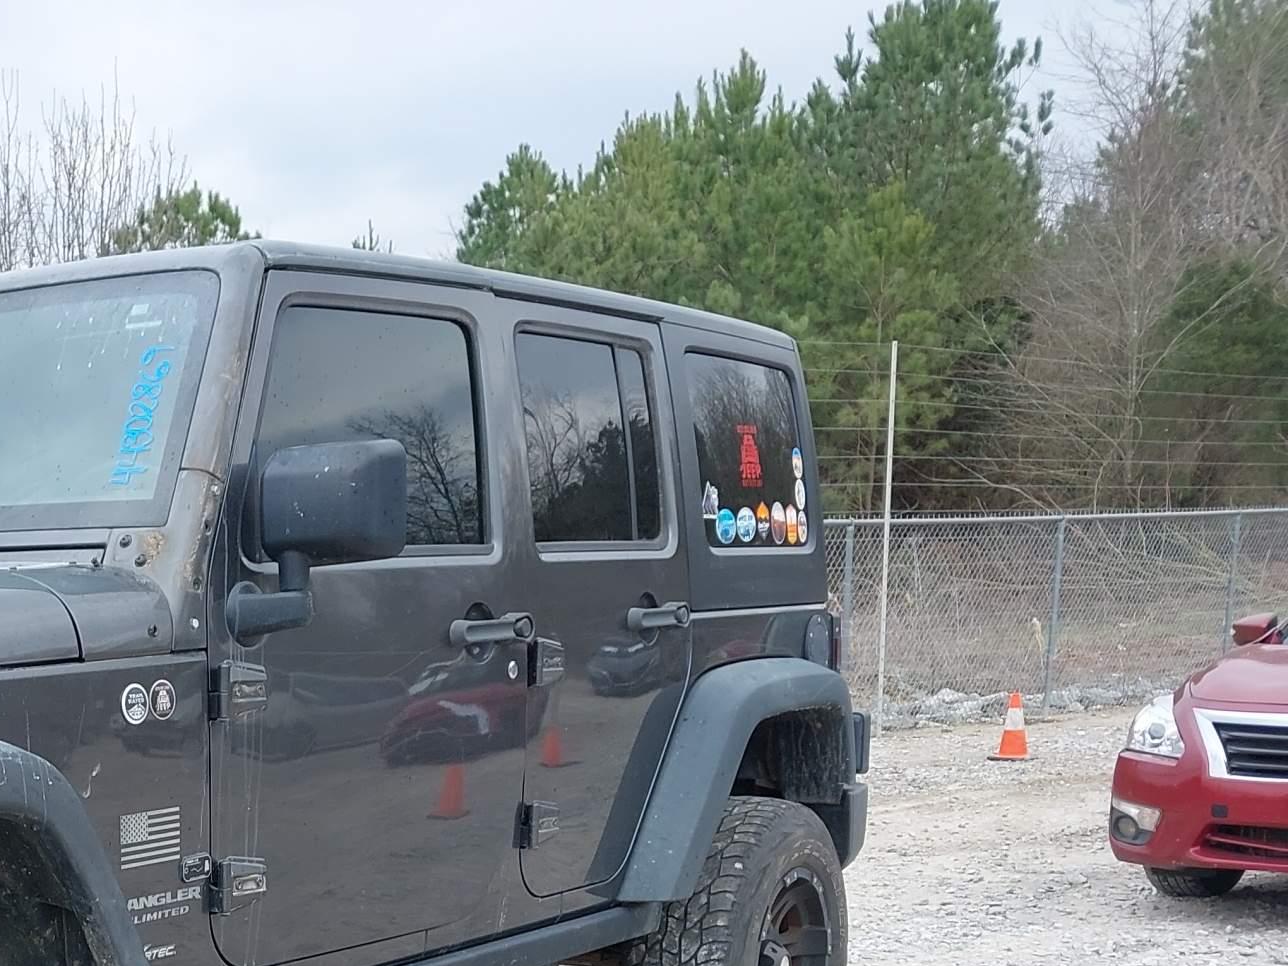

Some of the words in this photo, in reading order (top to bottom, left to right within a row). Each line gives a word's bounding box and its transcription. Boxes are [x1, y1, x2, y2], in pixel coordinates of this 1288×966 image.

[109, 345, 175, 486] 44302869
[126, 886, 202, 912] ANGLER
[132, 905, 190, 925] LIMITED
